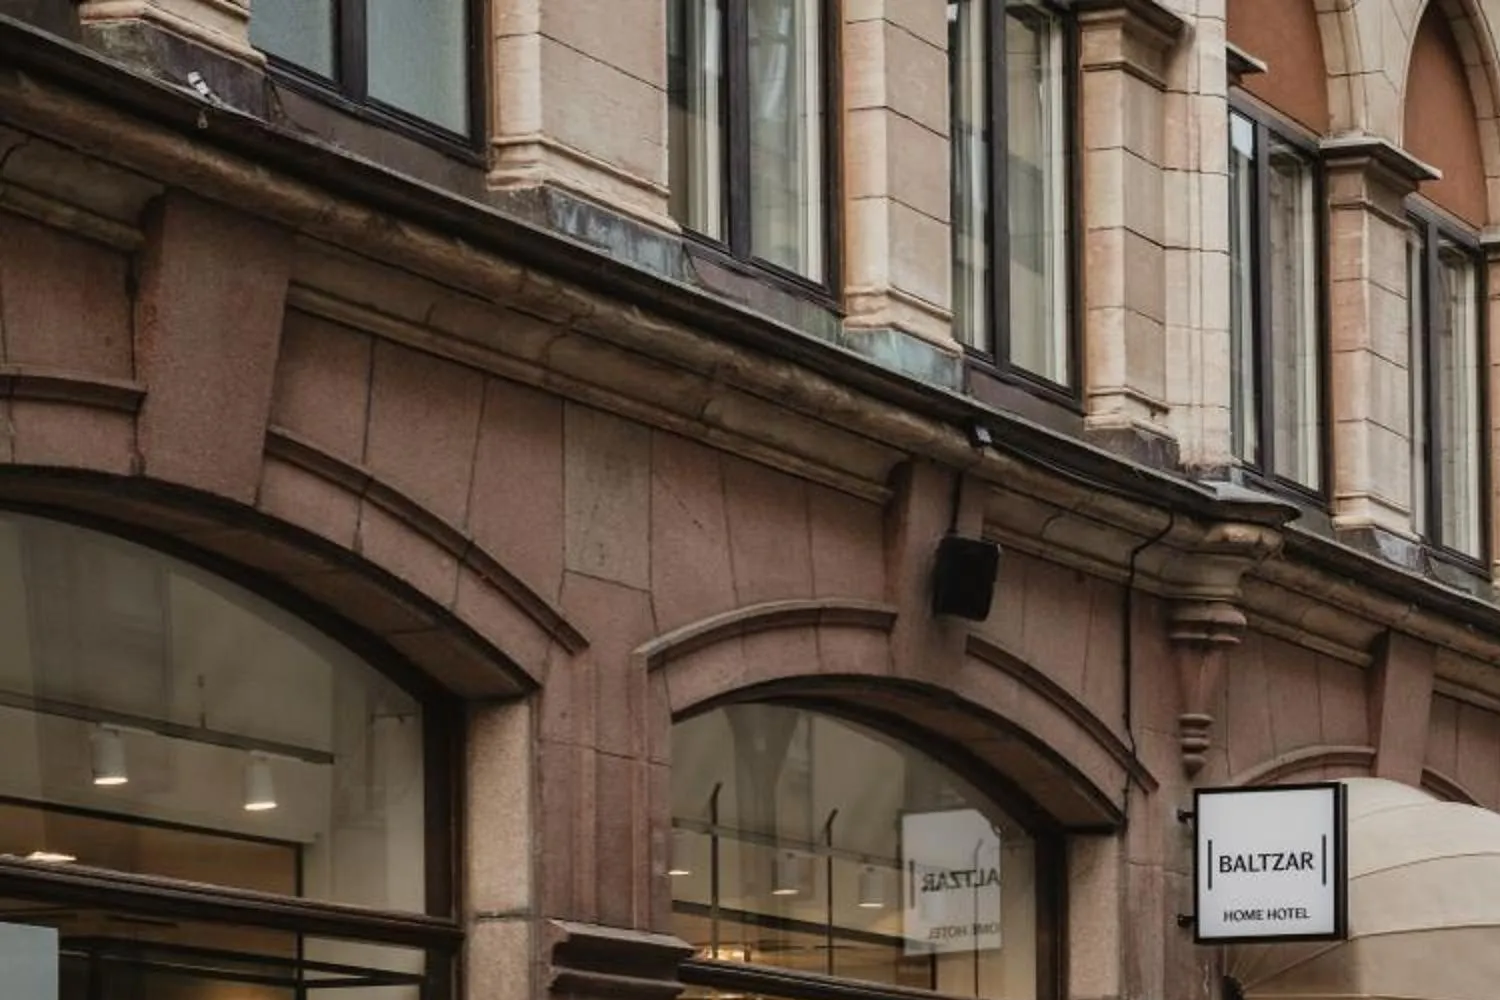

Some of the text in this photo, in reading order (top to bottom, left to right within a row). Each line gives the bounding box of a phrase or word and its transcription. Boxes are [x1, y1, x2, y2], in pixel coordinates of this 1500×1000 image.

[1219, 851, 1315, 873] BALTZAR
[1223, 907, 1311, 922] HOME HOTEL
